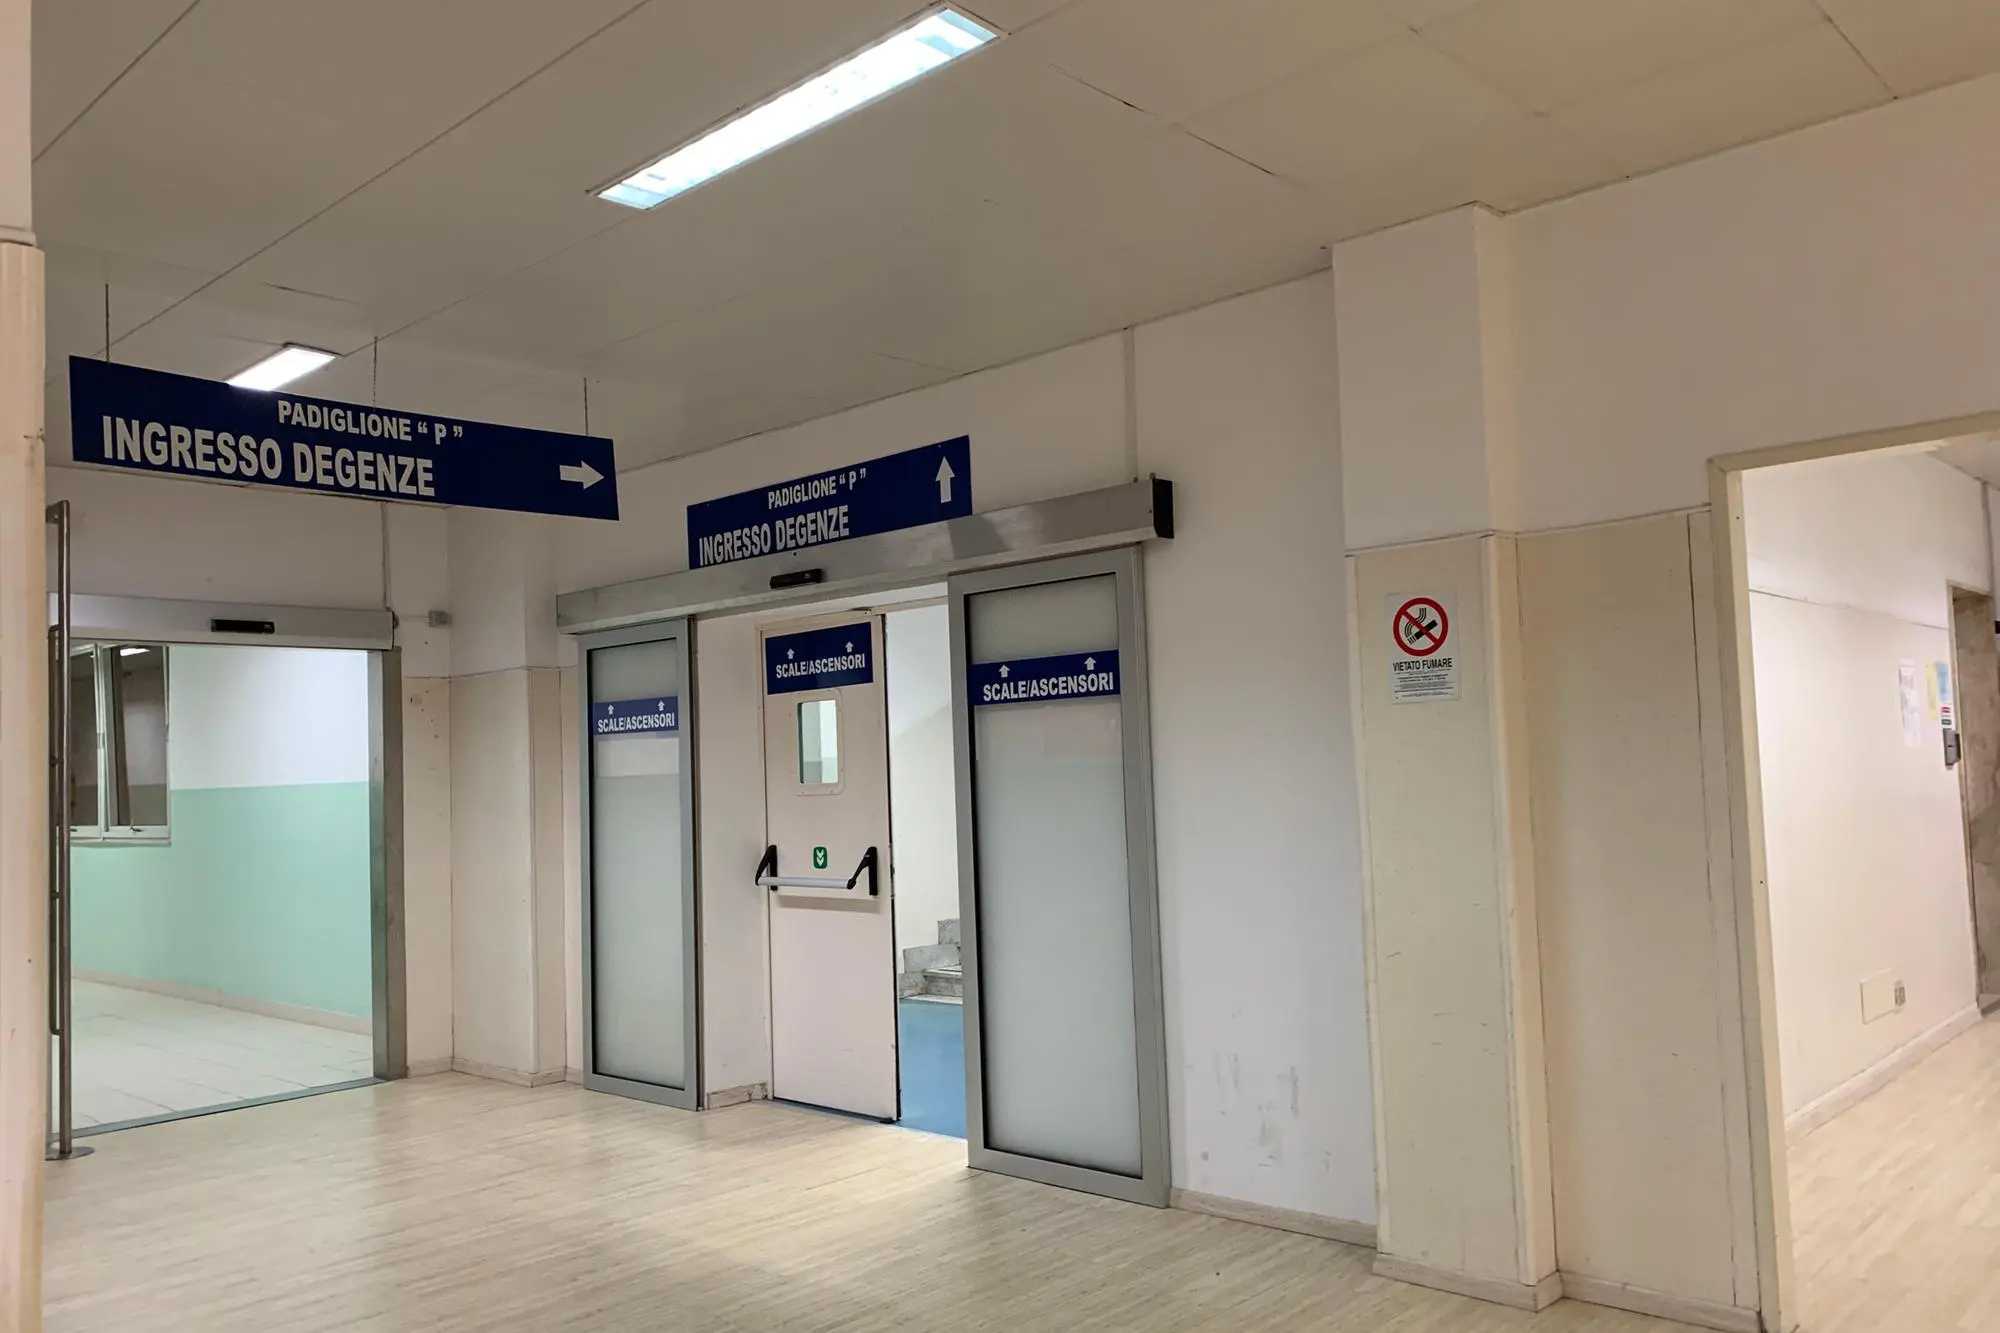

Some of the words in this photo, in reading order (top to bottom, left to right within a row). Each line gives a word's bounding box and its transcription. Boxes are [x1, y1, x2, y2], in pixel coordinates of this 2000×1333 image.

[277, 399, 412, 441] PADIGLIONE
[102, 415, 282, 480] INGRESSO
[293, 442, 435, 496] DEGENZE
[768, 475, 837, 510] PADIGLIONE
[699, 522, 771, 567] INGRESSO
[775, 504, 850, 551] DEGENZE
[775, 653, 866, 679] SCALE/ASCENSORI
[1392, 660, 1421, 672] VIETATO
[1422, 657, 1453, 669] FUMARE
[983, 672, 1114, 701] SCALE/ASCENSORI
[597, 712, 675, 733] SCALE/ASCENSORI
